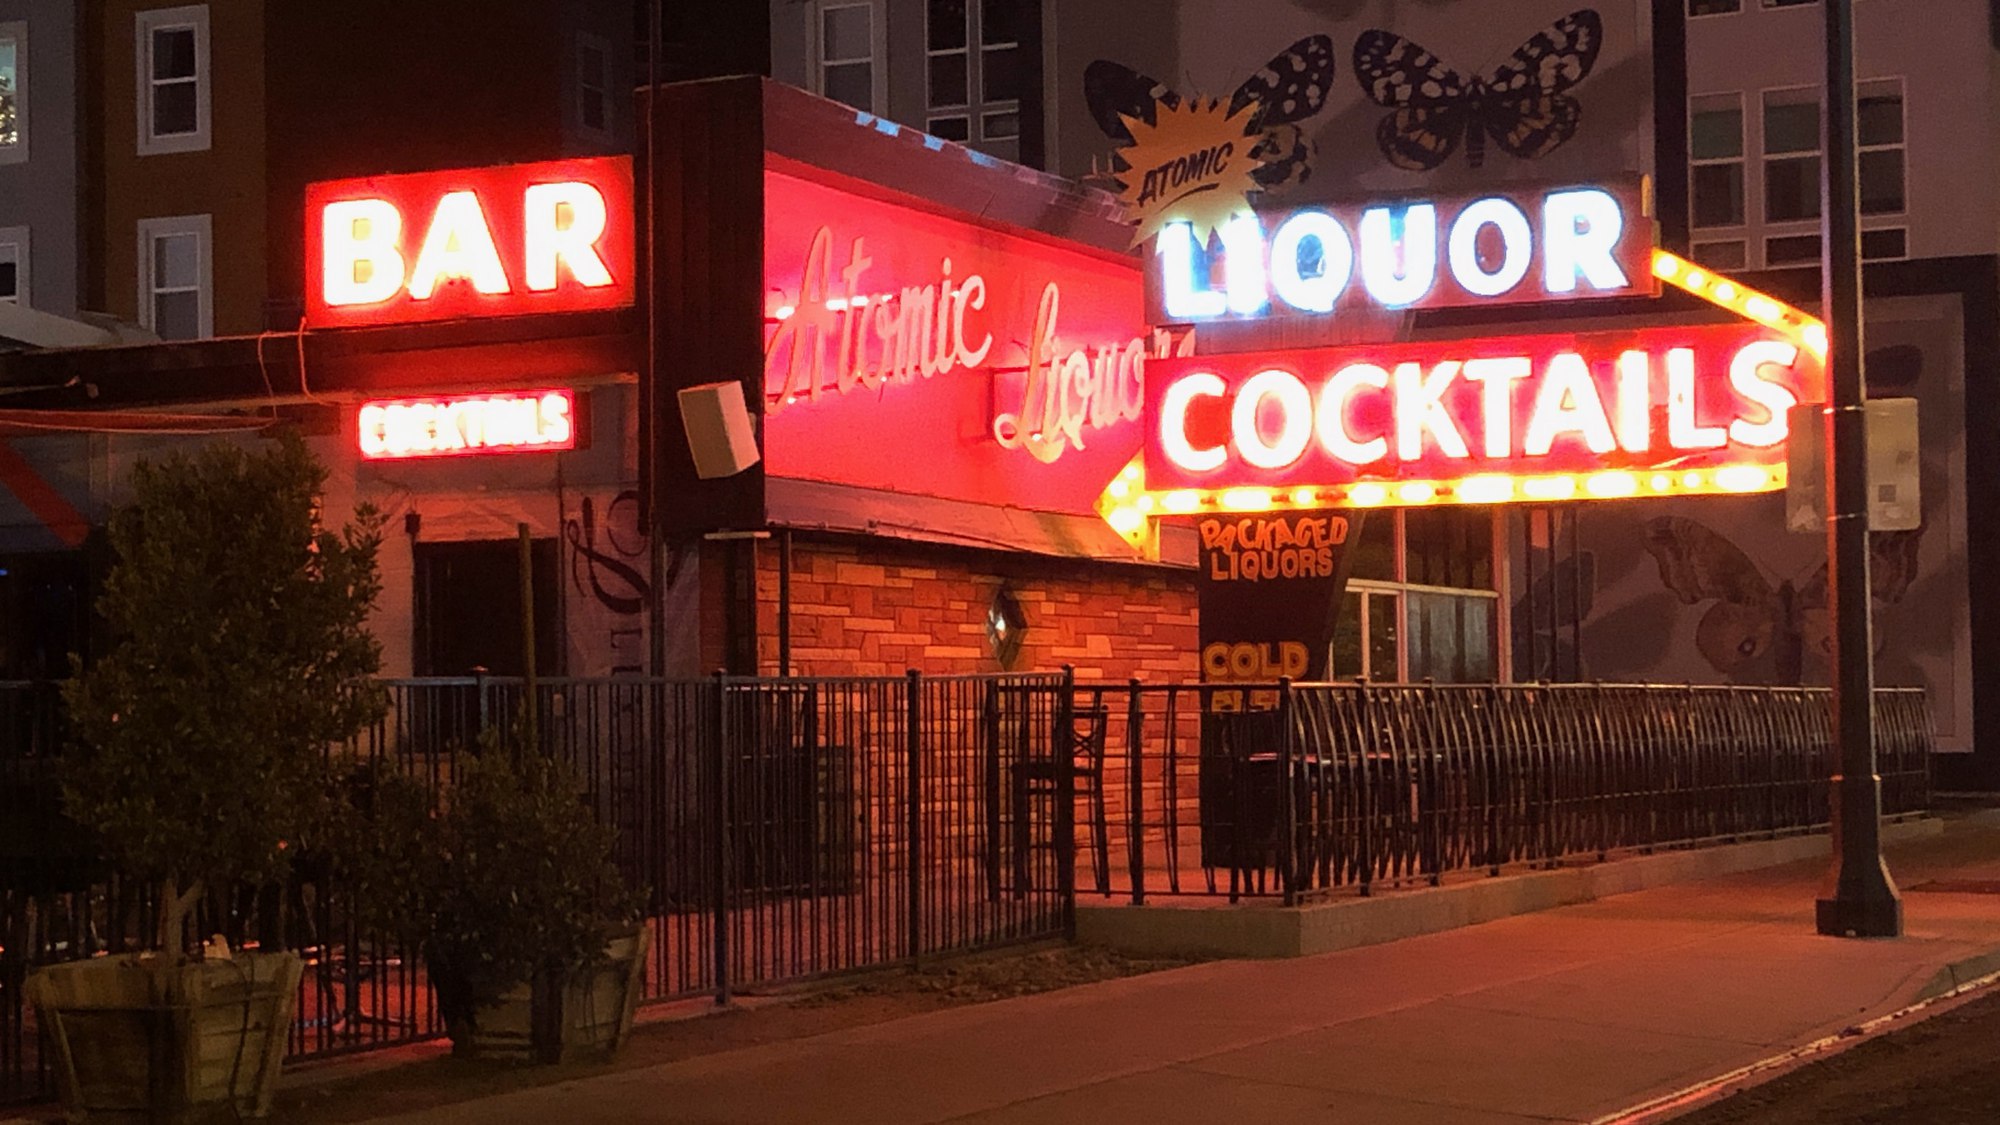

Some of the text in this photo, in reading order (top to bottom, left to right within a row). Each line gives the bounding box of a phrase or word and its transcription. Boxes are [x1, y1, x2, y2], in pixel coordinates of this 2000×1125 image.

[1136, 142, 1234, 208] ATOMIC
[323, 181, 617, 306] BAR
[1157, 189, 1631, 318] LIQUOR
[765, 225, 993, 416] Atomic
[1161, 340, 1798, 471] COCKTAILS
[1200, 516, 1349, 556] PACKAGED
[1212, 548, 1334, 582] LIQUORS
[1203, 641, 1309, 684] COLD
